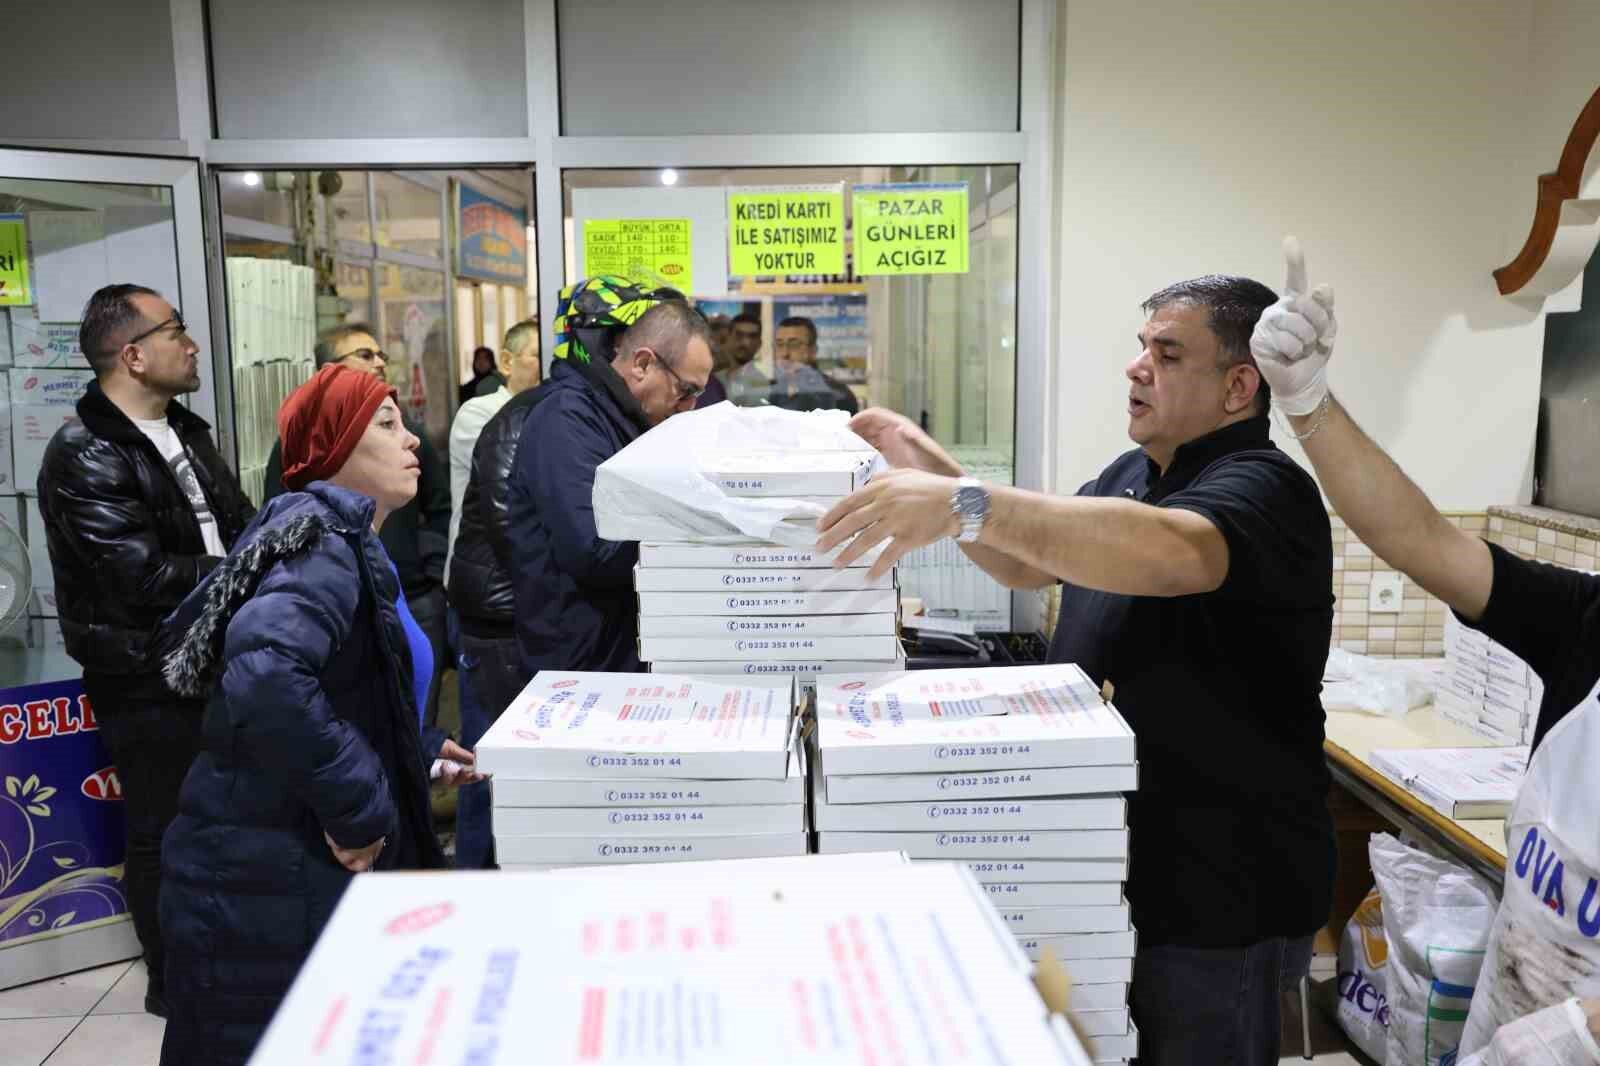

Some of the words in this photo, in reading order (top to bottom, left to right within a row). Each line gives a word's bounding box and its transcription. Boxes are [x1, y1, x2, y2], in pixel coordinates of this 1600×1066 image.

[736, 200, 781, 220] KREDİ
[786, 201, 831, 219] KARTI
[878, 199, 943, 216] PAZAR
[658, 223, 681, 231] ORTA
[866, 220, 955, 242] GÜNLERİ
[735, 226, 759, 245] İLE
[763, 227, 837, 247] SATIŞIMIZ
[755, 252, 815, 270] YOKTUR
[876, 246, 947, 270] AÇIĞIZ
[751, 480, 763, 489] 44
[800, 554, 812, 562] 44
[740, 622, 761, 630] 0332
[747, 641, 769, 649] 0332
[789, 641, 799, 649] 01
[802, 640, 814, 648] 44
[756, 665, 779, 673] 0332
[950, 747, 976, 757] 0332
[979, 746, 998, 756] 352
[1001, 746, 1014, 755] 01
[1016, 745, 1030, 753] 44
[602, 757, 628, 766] 0332
[631, 758, 650, 766] 352
[652, 758, 665, 767] 01
[668, 757, 681, 766] 44
[952, 778, 979, 787] 0332
[981, 776, 1000, 785] 352
[1003, 775, 1015, 784] 01
[1018, 774, 1032, 783] 44
[620, 791, 646, 800] 0332
[649, 791, 668, 800] 352
[671, 791, 683, 799] 01
[687, 791, 700, 799] 44
[942, 807, 968, 816] 0332
[971, 806, 990, 815] 352
[992, 806, 1005, 815] 01
[1008, 805, 1021, 814] 44
[624, 813, 649, 822] 0332
[652, 812, 672, 822] 352
[674, 812, 687, 822] 01
[690, 812, 704, 820] 44
[951, 835, 977, 844] 0332
[980, 835, 999, 844] 352
[1001, 835, 1014, 843] 01
[1017, 834, 1031, 843] 44
[613, 845, 639, 854] 0332
[975, 863, 993, 872] 352
[996, 863, 1008, 872] 01
[1011, 863, 1025, 871] 44
[1514, 826, 1566, 917] OVA
[990, 885, 1002, 893] 01
[1005, 885, 1019, 893] 44
[1025, 941, 1038, 949] 44
